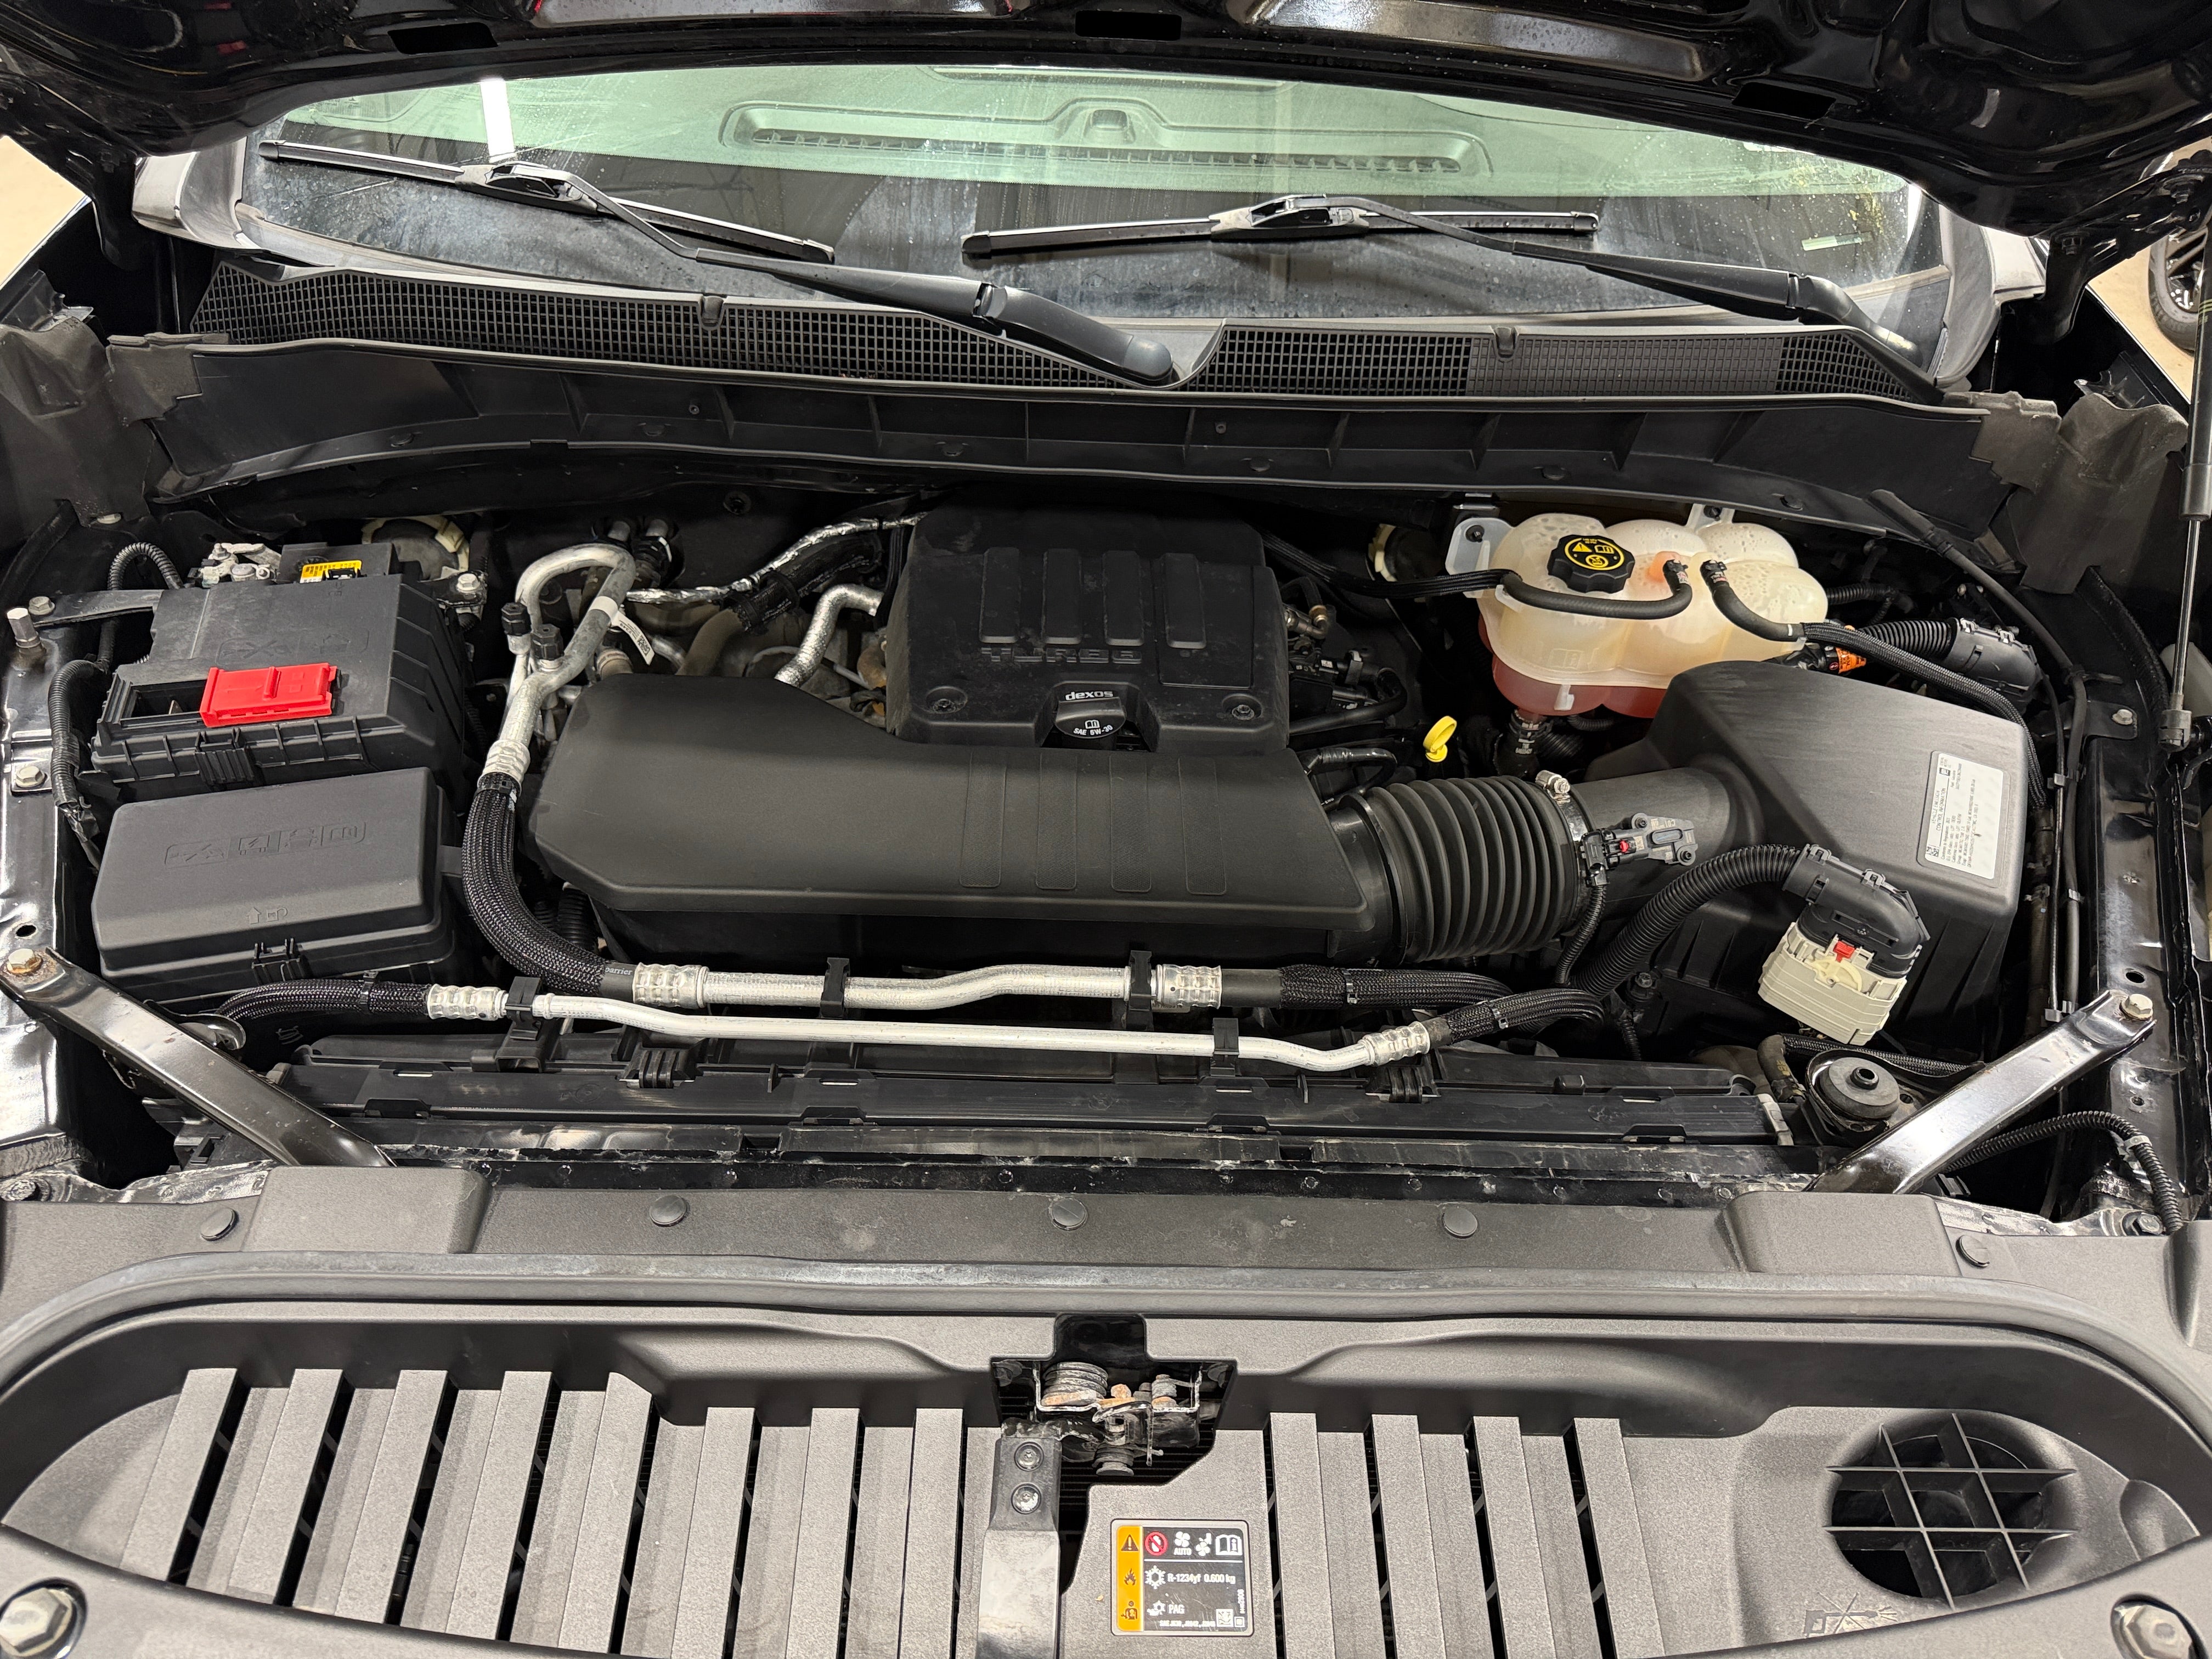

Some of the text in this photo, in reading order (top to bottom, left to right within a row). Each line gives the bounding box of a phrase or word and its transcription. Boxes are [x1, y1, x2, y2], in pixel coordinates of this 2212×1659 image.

[980, 647, 1142, 664] TURBO
[1065, 690, 1114, 701] dexos
[1073, 725, 1113, 736] SAE 5W-30
[1173, 1548, 1192, 1556] AUTO
[1167, 1574, 1236, 1584] R-1234yf 0.600 kg
[1169, 1604, 1184, 1614] PAG
